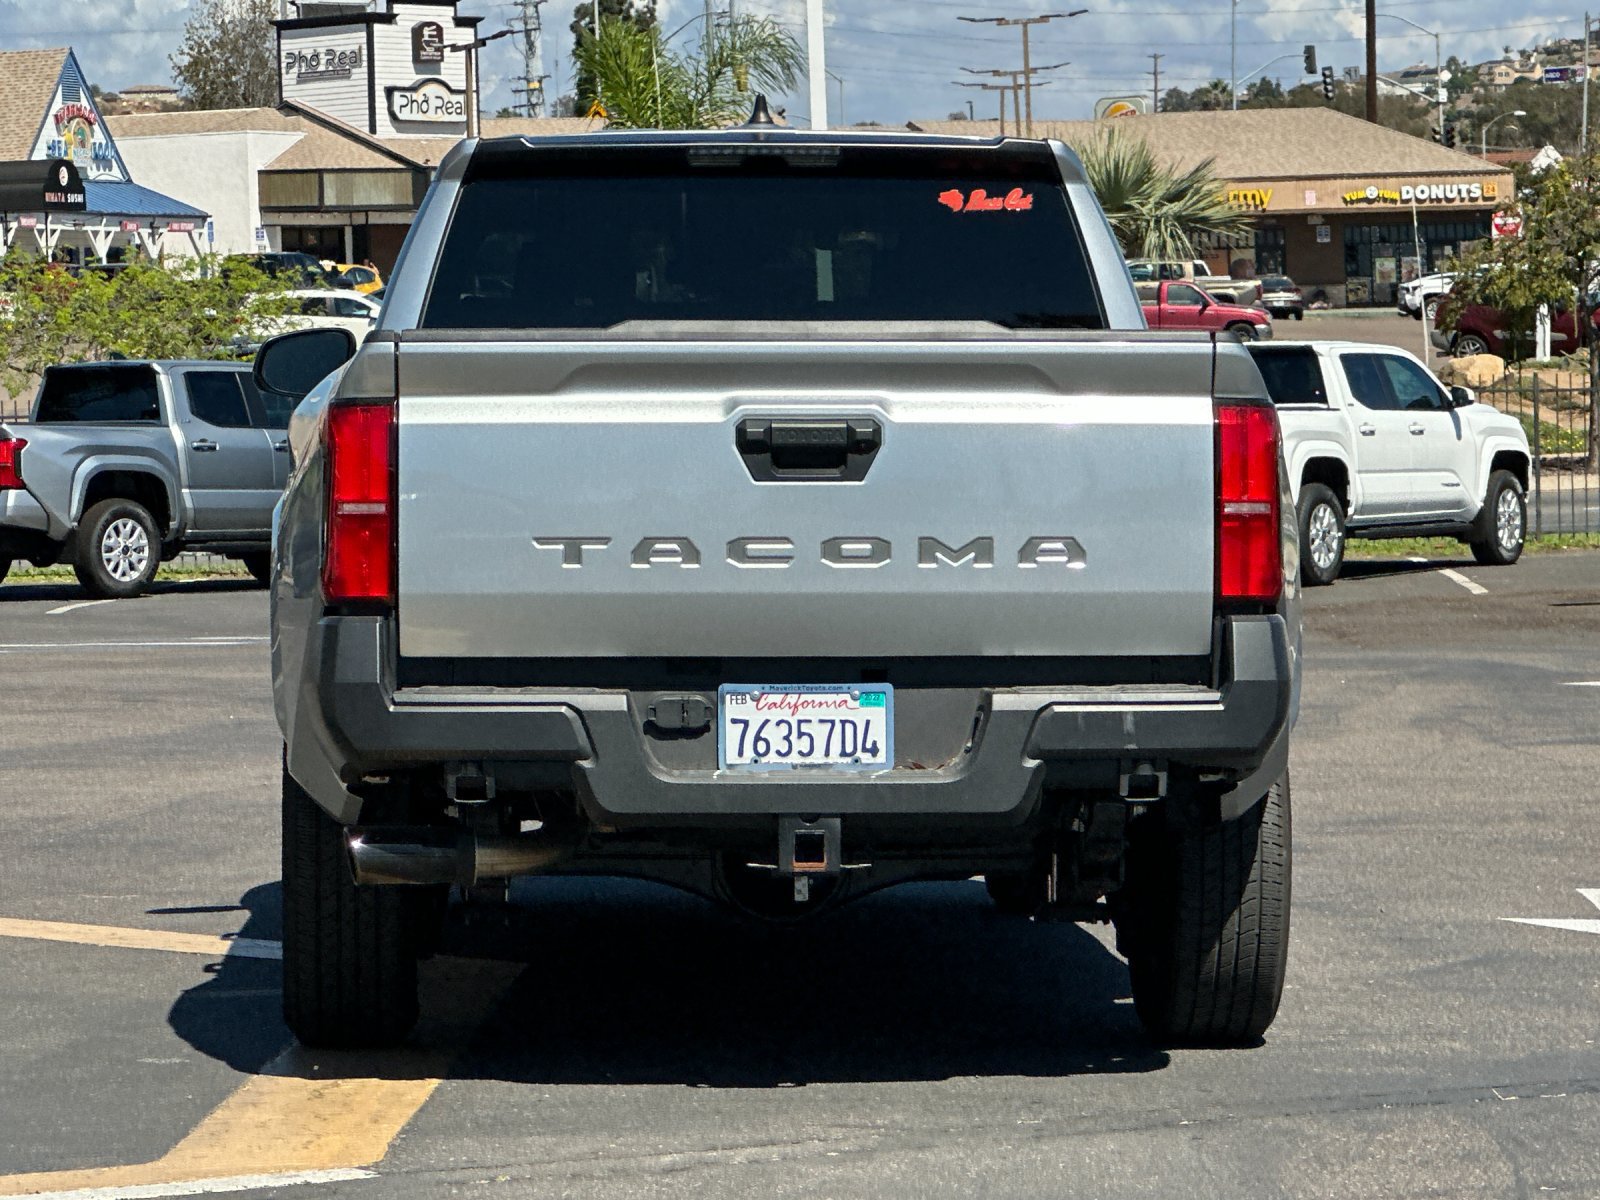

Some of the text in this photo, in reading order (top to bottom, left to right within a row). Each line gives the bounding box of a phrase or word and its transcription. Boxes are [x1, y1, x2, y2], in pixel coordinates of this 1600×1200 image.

[325, 45, 362, 68] Real
[434, 95, 466, 116] Real
[67, 193, 84, 203] SUSHI
[1343, 183, 1482, 202] YUM YUM DONUTS
[776, 430, 844, 442] TOYOTA
[532, 536, 1087, 568] TACOMA
[730, 694, 747, 705] FEB
[755, 693, 859, 717] California
[730, 717, 880, 758] 76357D4
